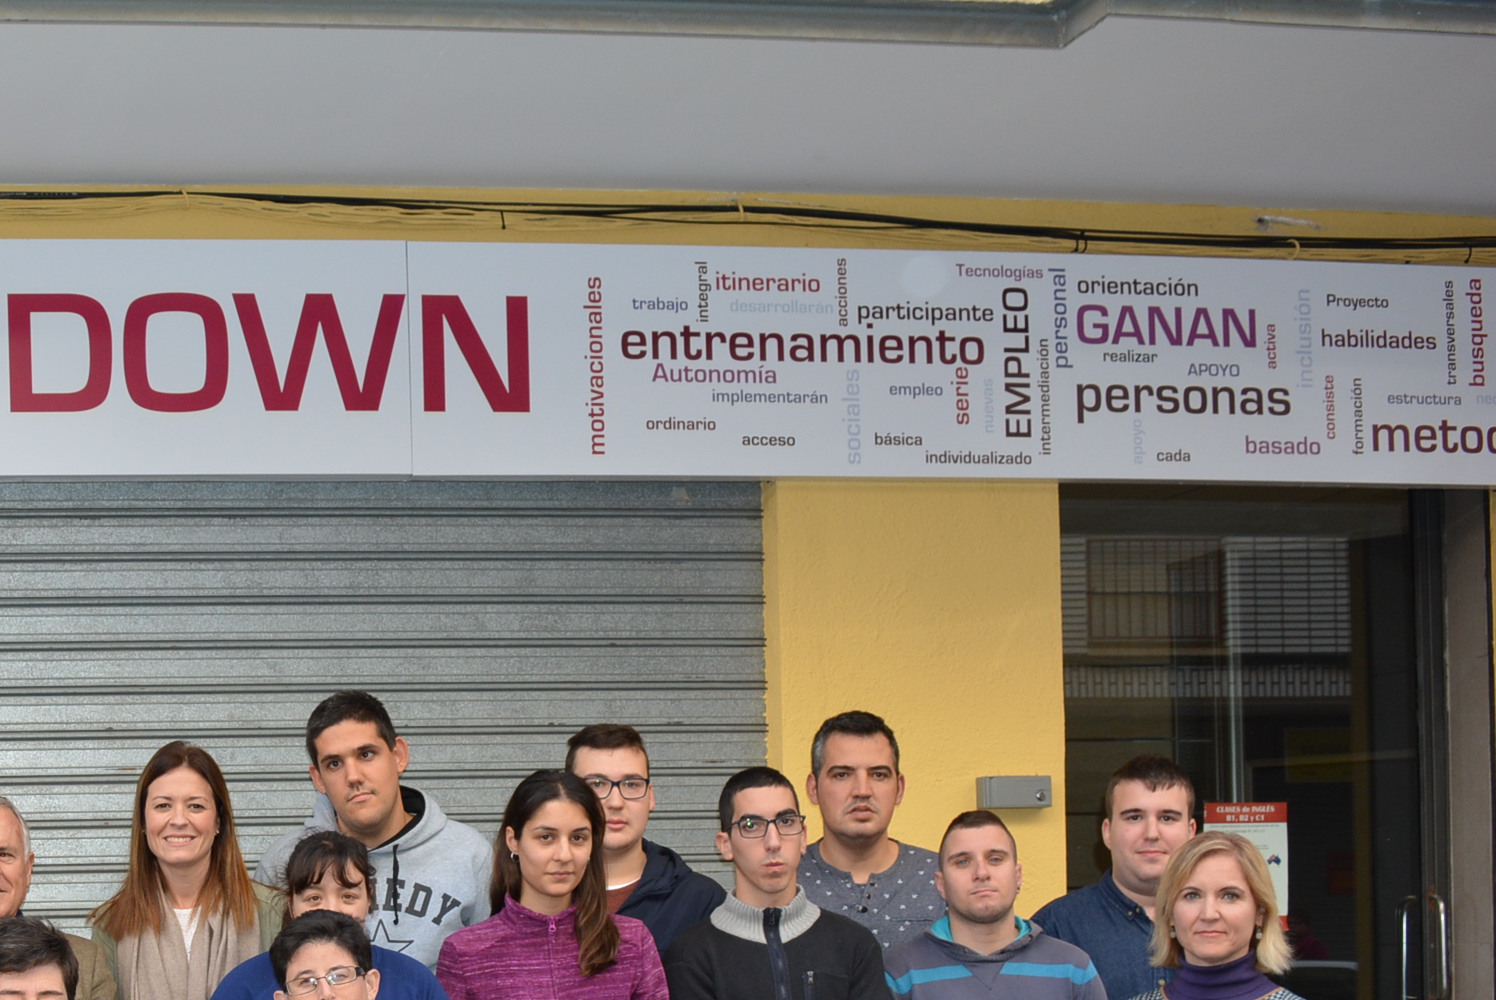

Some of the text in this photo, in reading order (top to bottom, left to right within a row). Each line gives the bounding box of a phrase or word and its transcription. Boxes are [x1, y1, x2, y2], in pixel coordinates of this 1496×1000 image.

[715, 270, 821, 293] itinerario
[956, 263, 1044, 282] Tecnologías
[695, 261, 712, 323] integral
[837, 257, 848, 327] acciones
[1077, 276, 1199, 297] orientación
[632, 297, 689, 314] trabajo
[729, 298, 834, 315] desarrollarán
[857, 300, 994, 326] participante
[1326, 293, 1390, 312] Proyecto
[1048, 267, 1074, 369] personal
[1076, 303, 1257, 349] GANAN
[1293, 287, 1313, 388] inclusión
[1321, 328, 1437, 350] habilidades
[1442, 280, 1459, 386] transversales
[1465, 278, 1489, 387] busqueda
[620, 323, 985, 366] entrenamiento
[1264, 323, 1277, 370] activa
[583, 276, 606, 455] motivacionales
[1002, 286, 1032, 438] EMPLEO
[1103, 349, 1159, 364] realizar
[651, 362, 777, 385] Autonomía
[1187, 362, 1241, 378] APOYO
[711, 388, 829, 407] implementarán
[889, 382, 944, 399] empleo
[950, 366, 970, 425] serie
[1037, 338, 1051, 456] intermediación
[1387, 392, 1462, 406] estructura
[983, 377, 994, 434] nuevas
[1076, 383, 1292, 424] personas
[1323, 374, 1336, 440] consiste
[645, 416, 717, 431] ordinario
[841, 368, 861, 465] sociales
[1351, 377, 1365, 456] formación
[742, 435, 796, 447] acceso
[874, 432, 923, 447] básica
[1245, 434, 1321, 456] basado
[925, 449, 1032, 465] individualizado
[1156, 448, 1191, 463] cada
[1216, 805, 1241, 813] CLASES
[1251, 804, 1275, 812] INGLÉS
